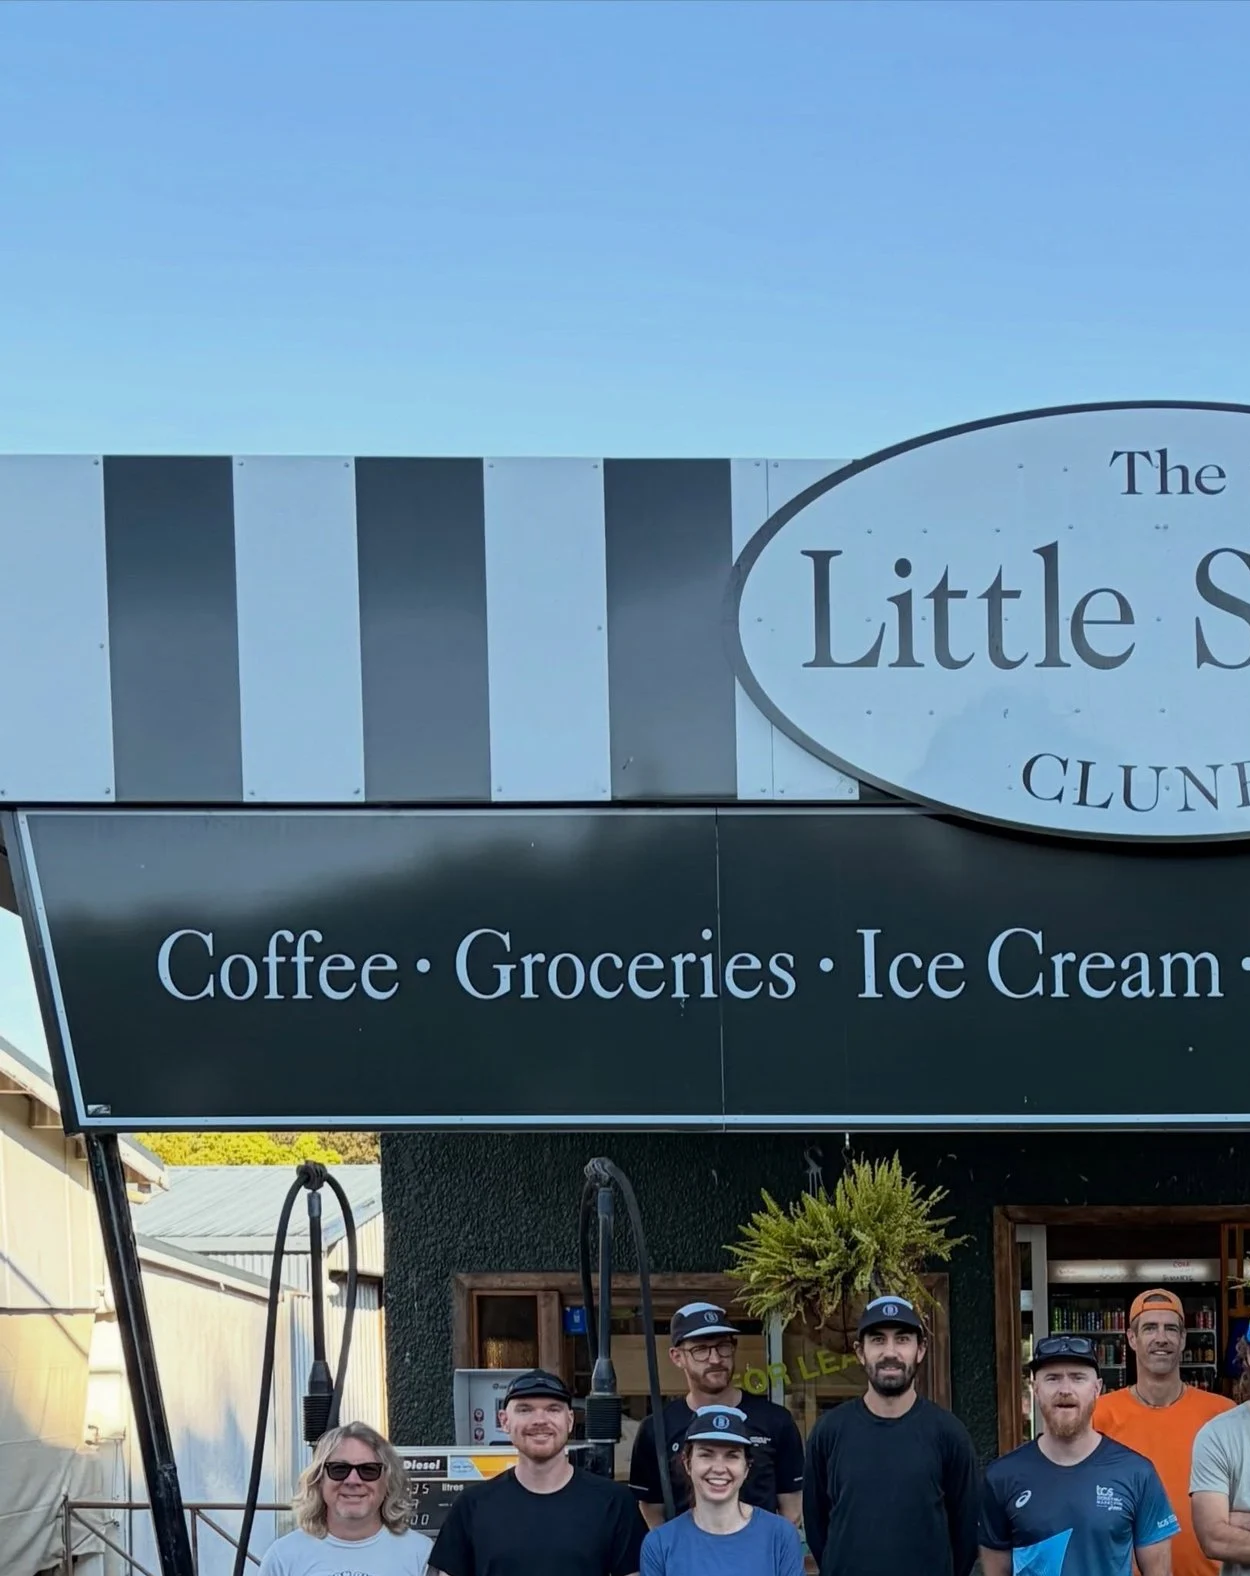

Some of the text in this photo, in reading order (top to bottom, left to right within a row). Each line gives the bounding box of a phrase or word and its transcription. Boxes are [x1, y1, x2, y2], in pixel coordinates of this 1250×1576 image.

[1109, 449, 1227, 496] The
[801, 541, 1137, 670] Little
[157, 928, 400, 1001] Coffee
[455, 928, 797, 1000] Groceries
[856, 928, 966, 998] Ice
[987, 927, 1224, 999] Cream
[403, 1459, 441, 1470] Diesel
